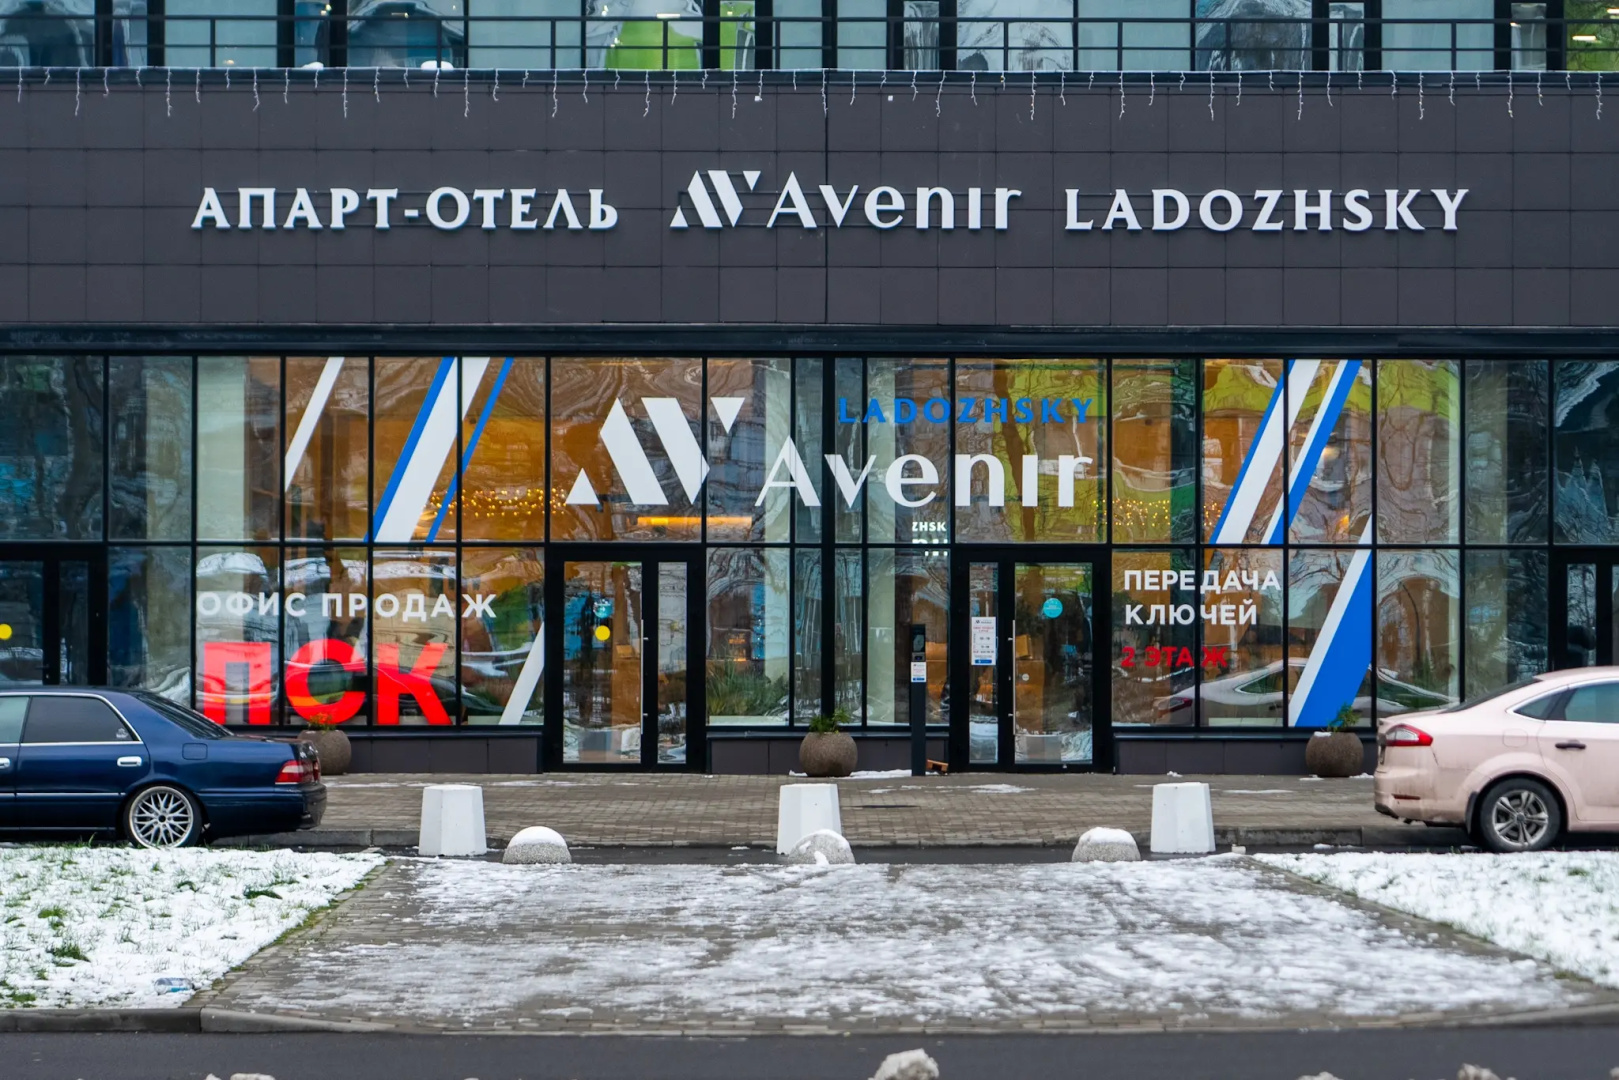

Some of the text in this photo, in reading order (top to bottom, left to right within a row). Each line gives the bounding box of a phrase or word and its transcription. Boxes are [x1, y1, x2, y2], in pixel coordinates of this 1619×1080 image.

[191, 170, 1469, 232] АПАРТ-ОТЕЛЬ Avenir LADOZHSKY
[838, 397, 1093, 424] LADOZHSKY
[754, 435, 1094, 509] Avenir
[1123, 569, 1281, 594] ПЕРЕДАЧА
[197, 593, 498, 622] ОФИС ПРОДАЖ
[1125, 598, 1257, 626] КЛЮЧЕЙ
[1120, 646, 1228, 667] 2 ЭТАЖ
[203, 638, 454, 725] ПСК
